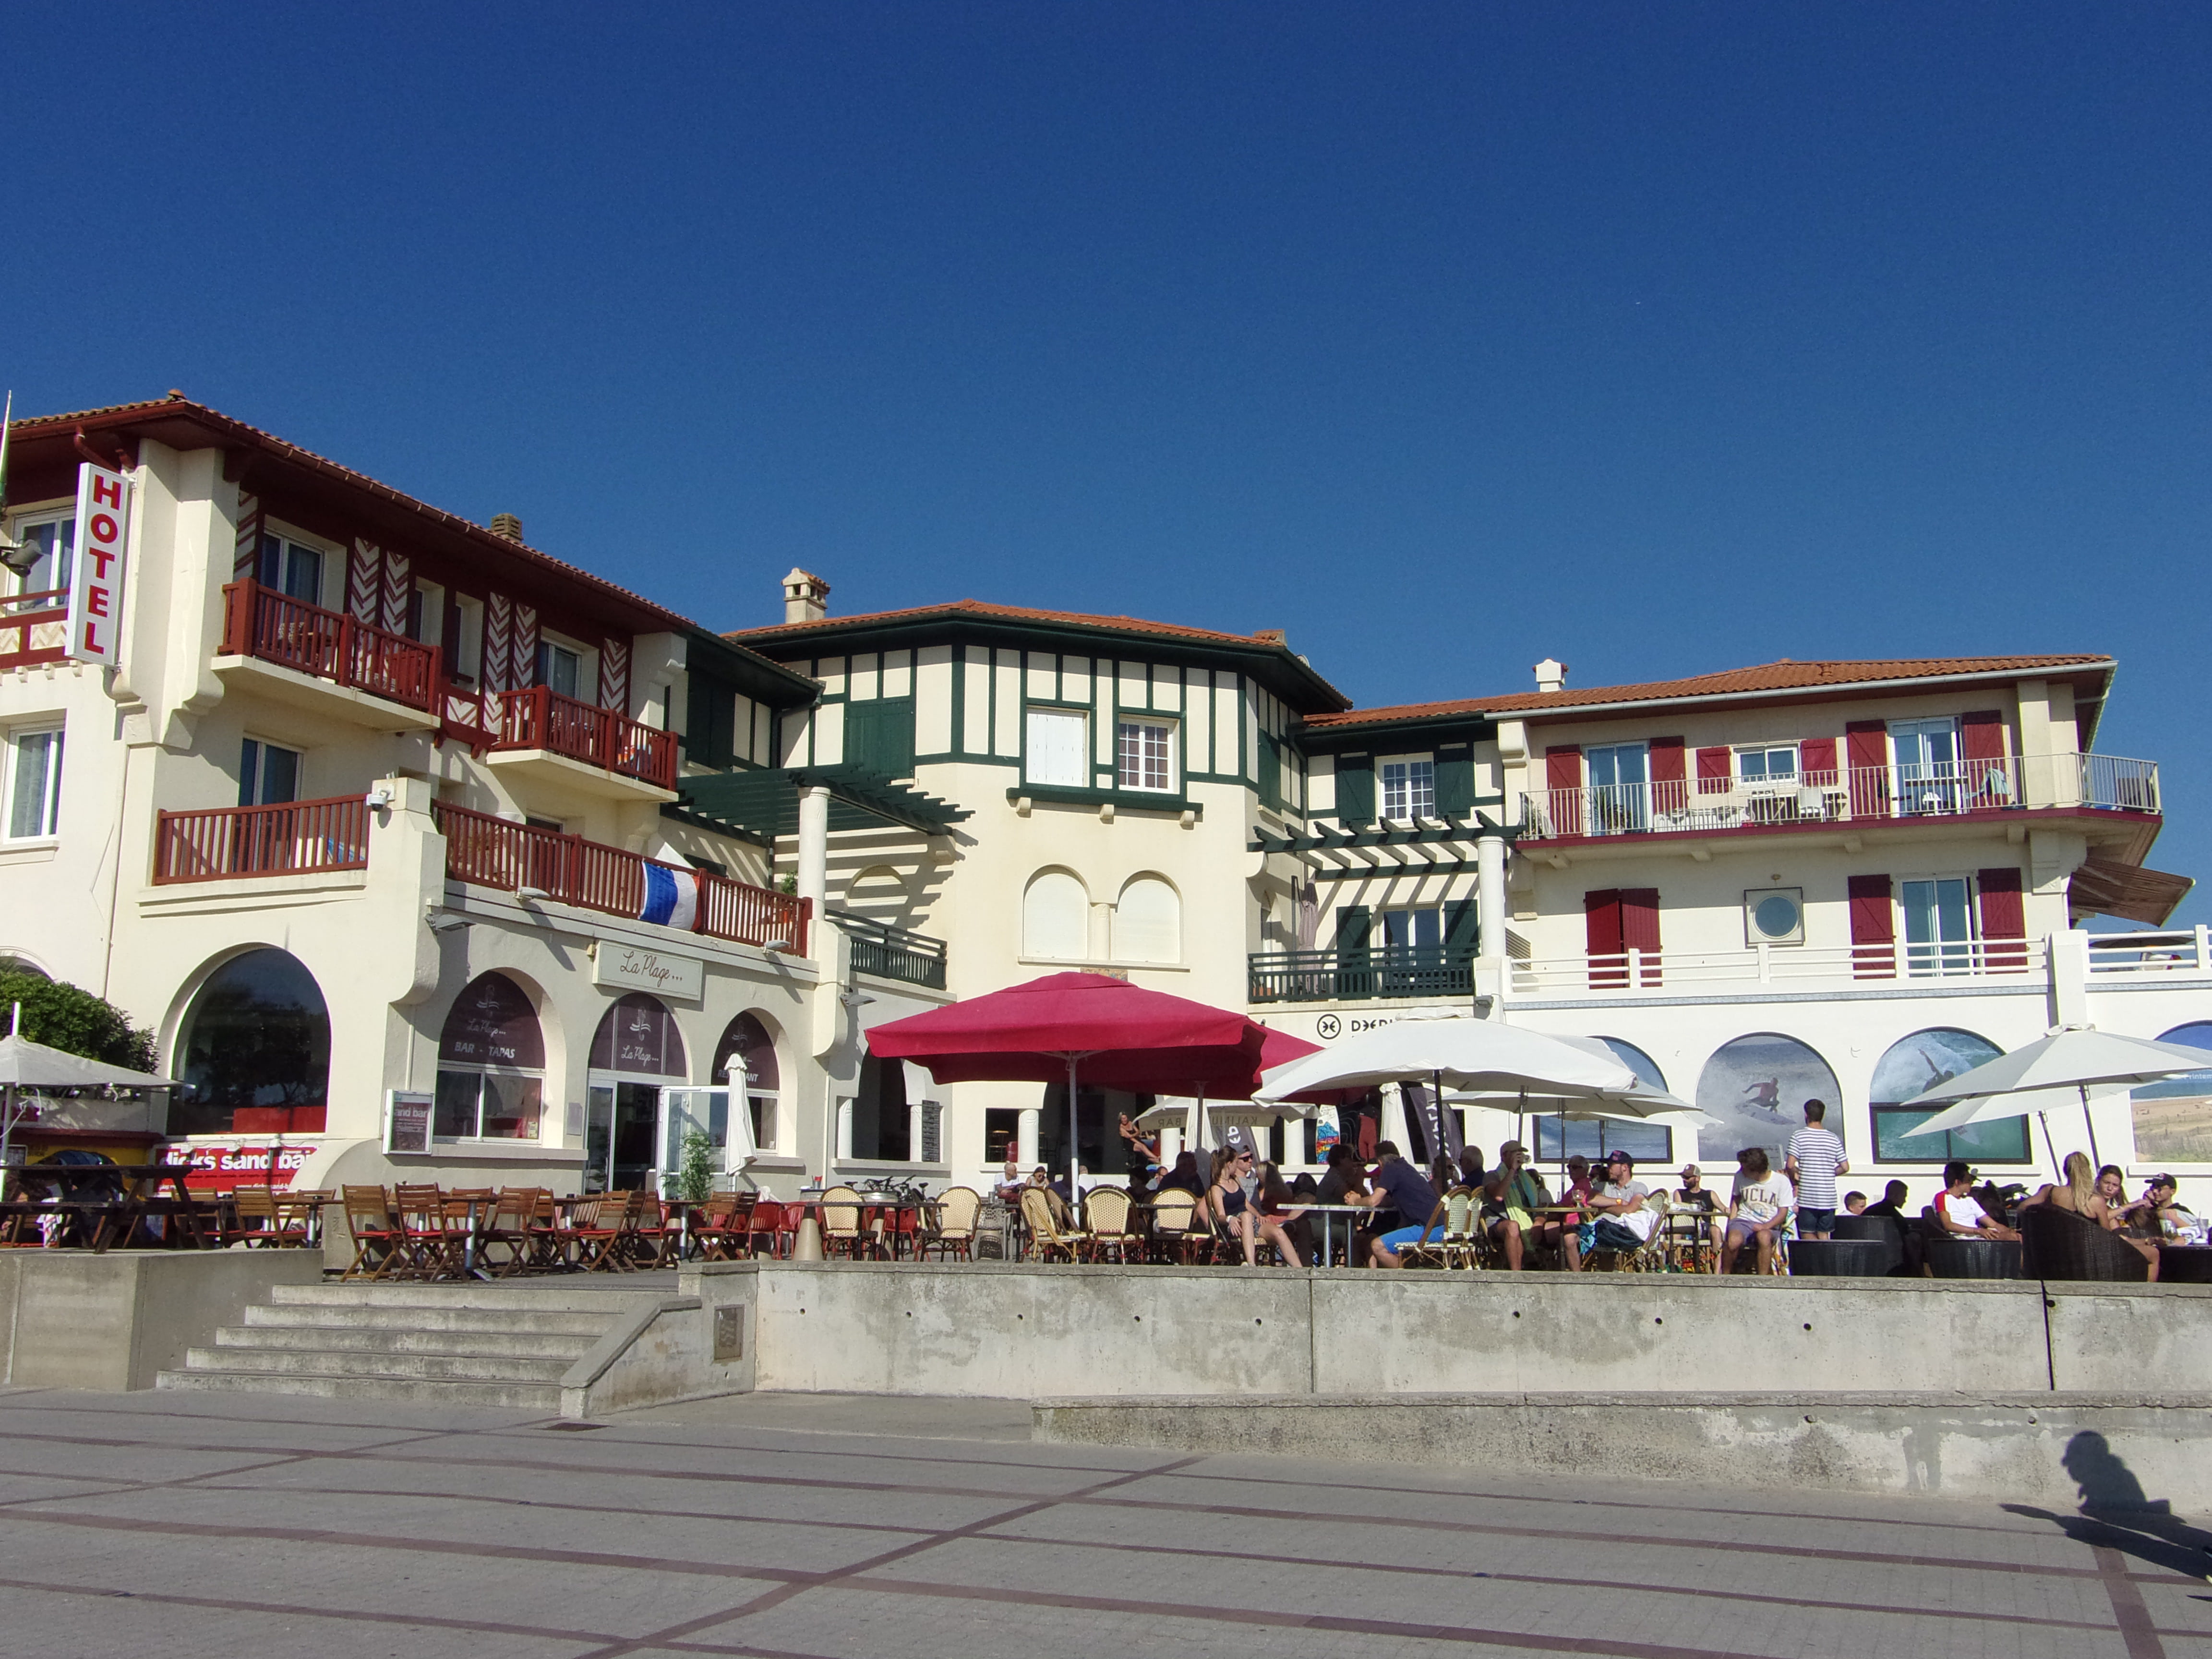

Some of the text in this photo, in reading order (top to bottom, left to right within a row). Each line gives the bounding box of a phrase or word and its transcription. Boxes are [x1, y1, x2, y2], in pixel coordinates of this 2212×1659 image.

[84, 474, 121, 655] HOTEL
[620, 951, 640, 974] La
[455, 1041, 475, 1054] BAR
[488, 1046, 516, 1059] TAPAS
[621, 1045, 634, 1059] La
[717, 1069, 759, 1082] RESANT
[394, 1107, 427, 1118] and bar
[220, 1152, 273, 1170] sand
[1740, 1188, 1779, 1207] UCLA
